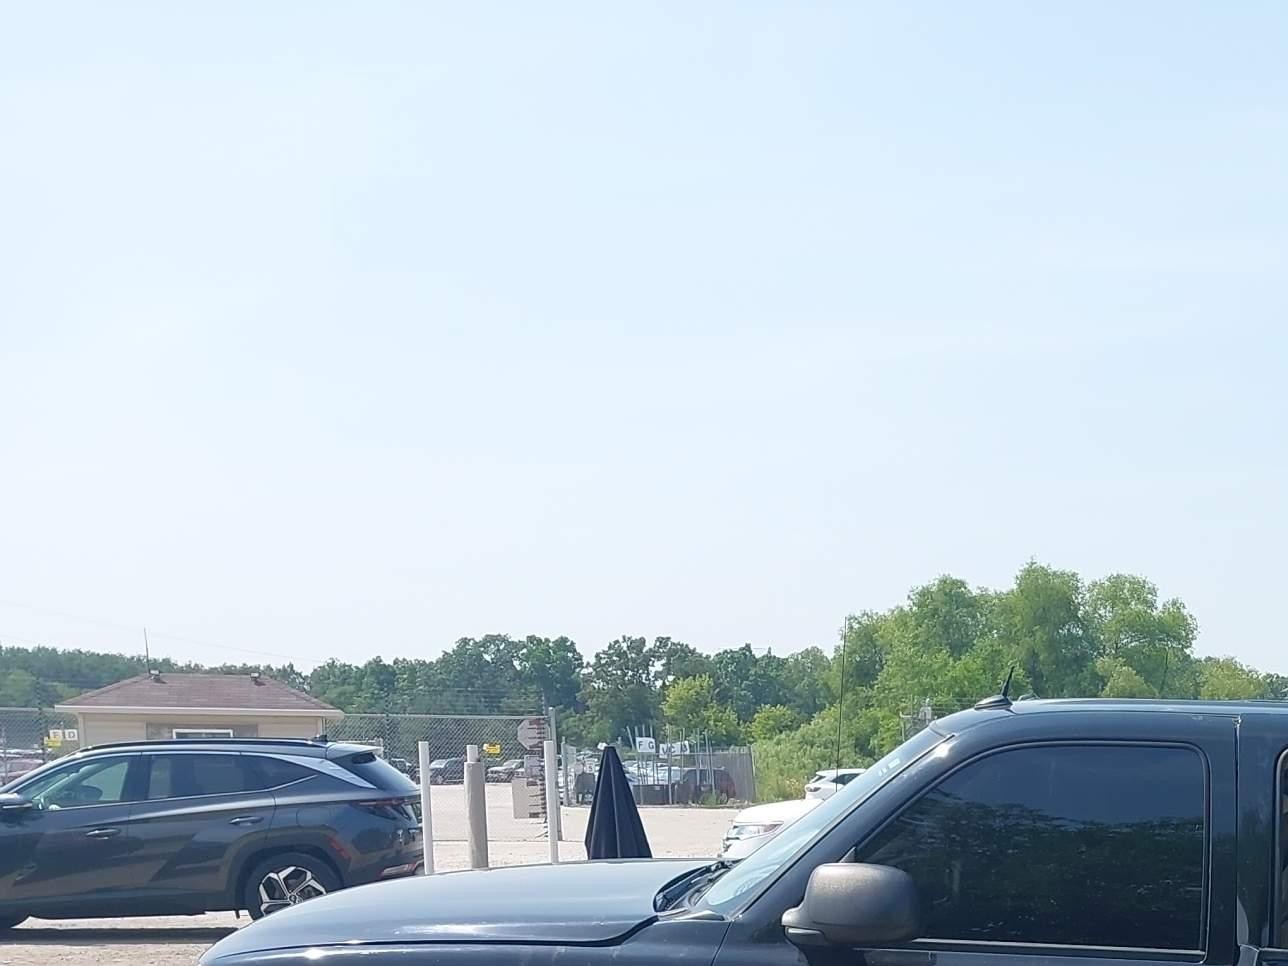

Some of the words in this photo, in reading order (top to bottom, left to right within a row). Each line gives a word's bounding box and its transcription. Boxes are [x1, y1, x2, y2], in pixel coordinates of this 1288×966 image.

[68, 731, 76, 739] D
[638, 741, 644, 750] F
[648, 741, 655, 750] G
